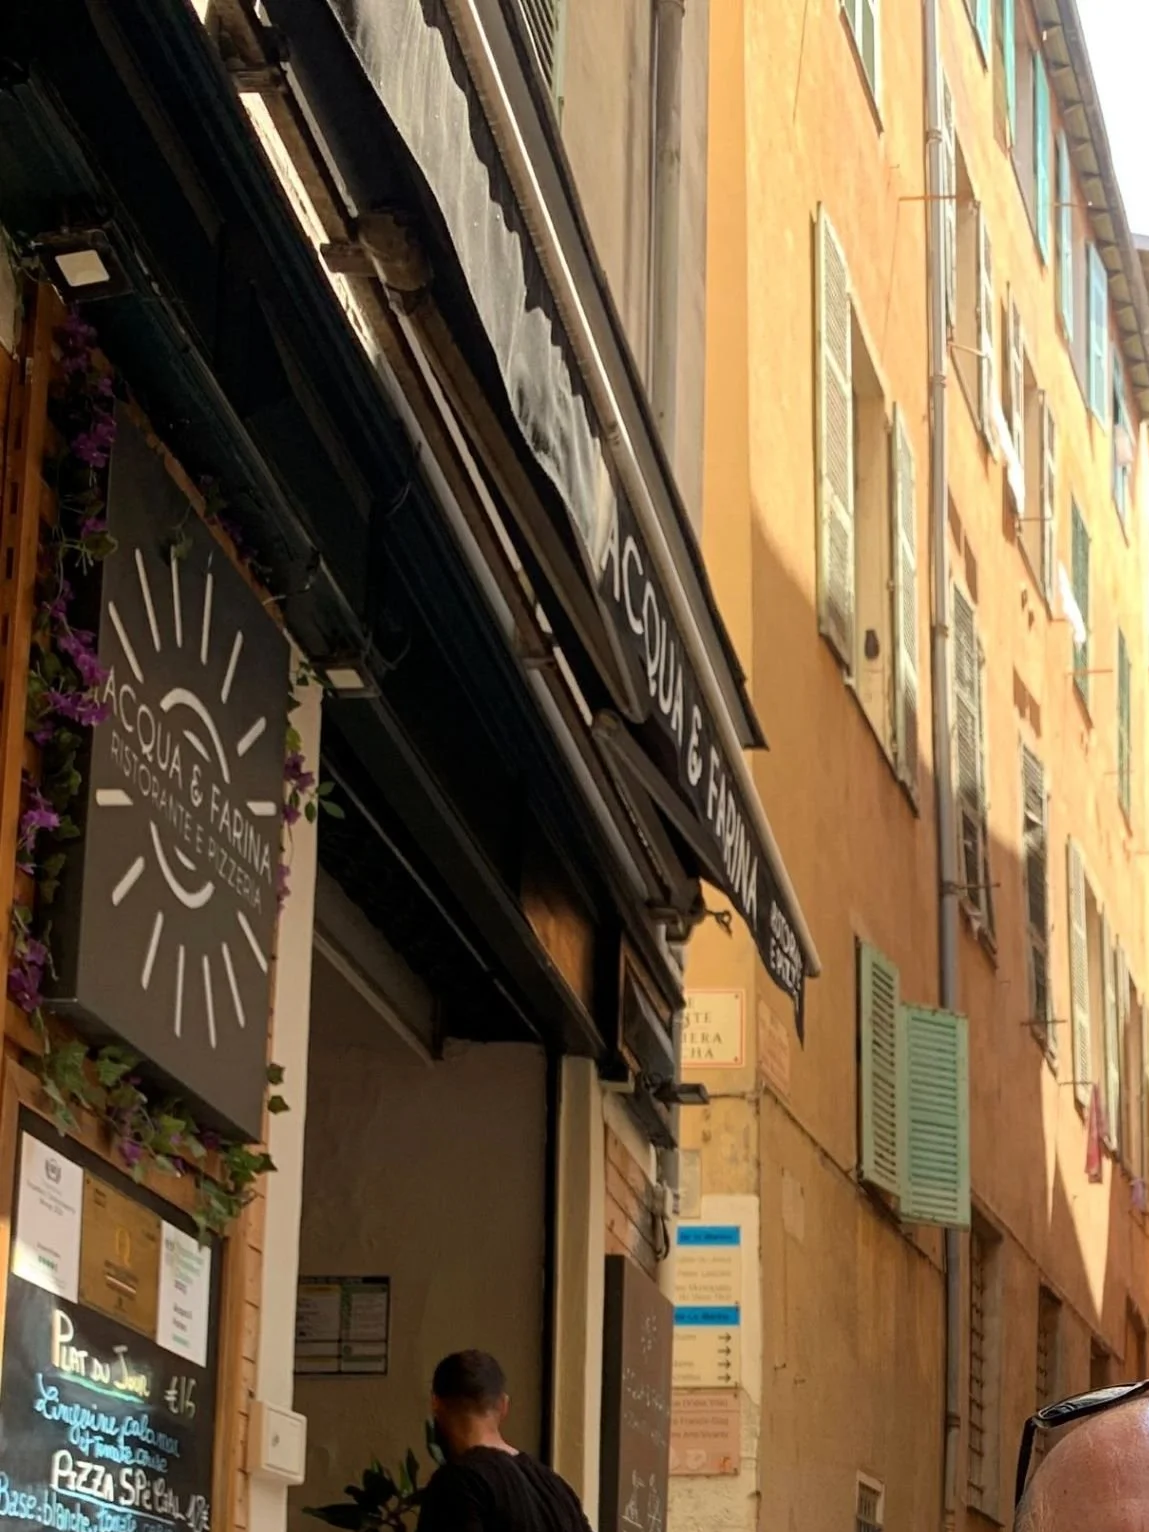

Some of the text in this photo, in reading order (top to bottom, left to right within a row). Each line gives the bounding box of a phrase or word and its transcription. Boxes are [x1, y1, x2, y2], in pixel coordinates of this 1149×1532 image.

[102, 664, 273, 885] ACQUA & FARINA
[110, 729, 262, 916] RISTORANTE E PIZZERIA
[600, 515, 759, 920] ACQUA & FARINA
